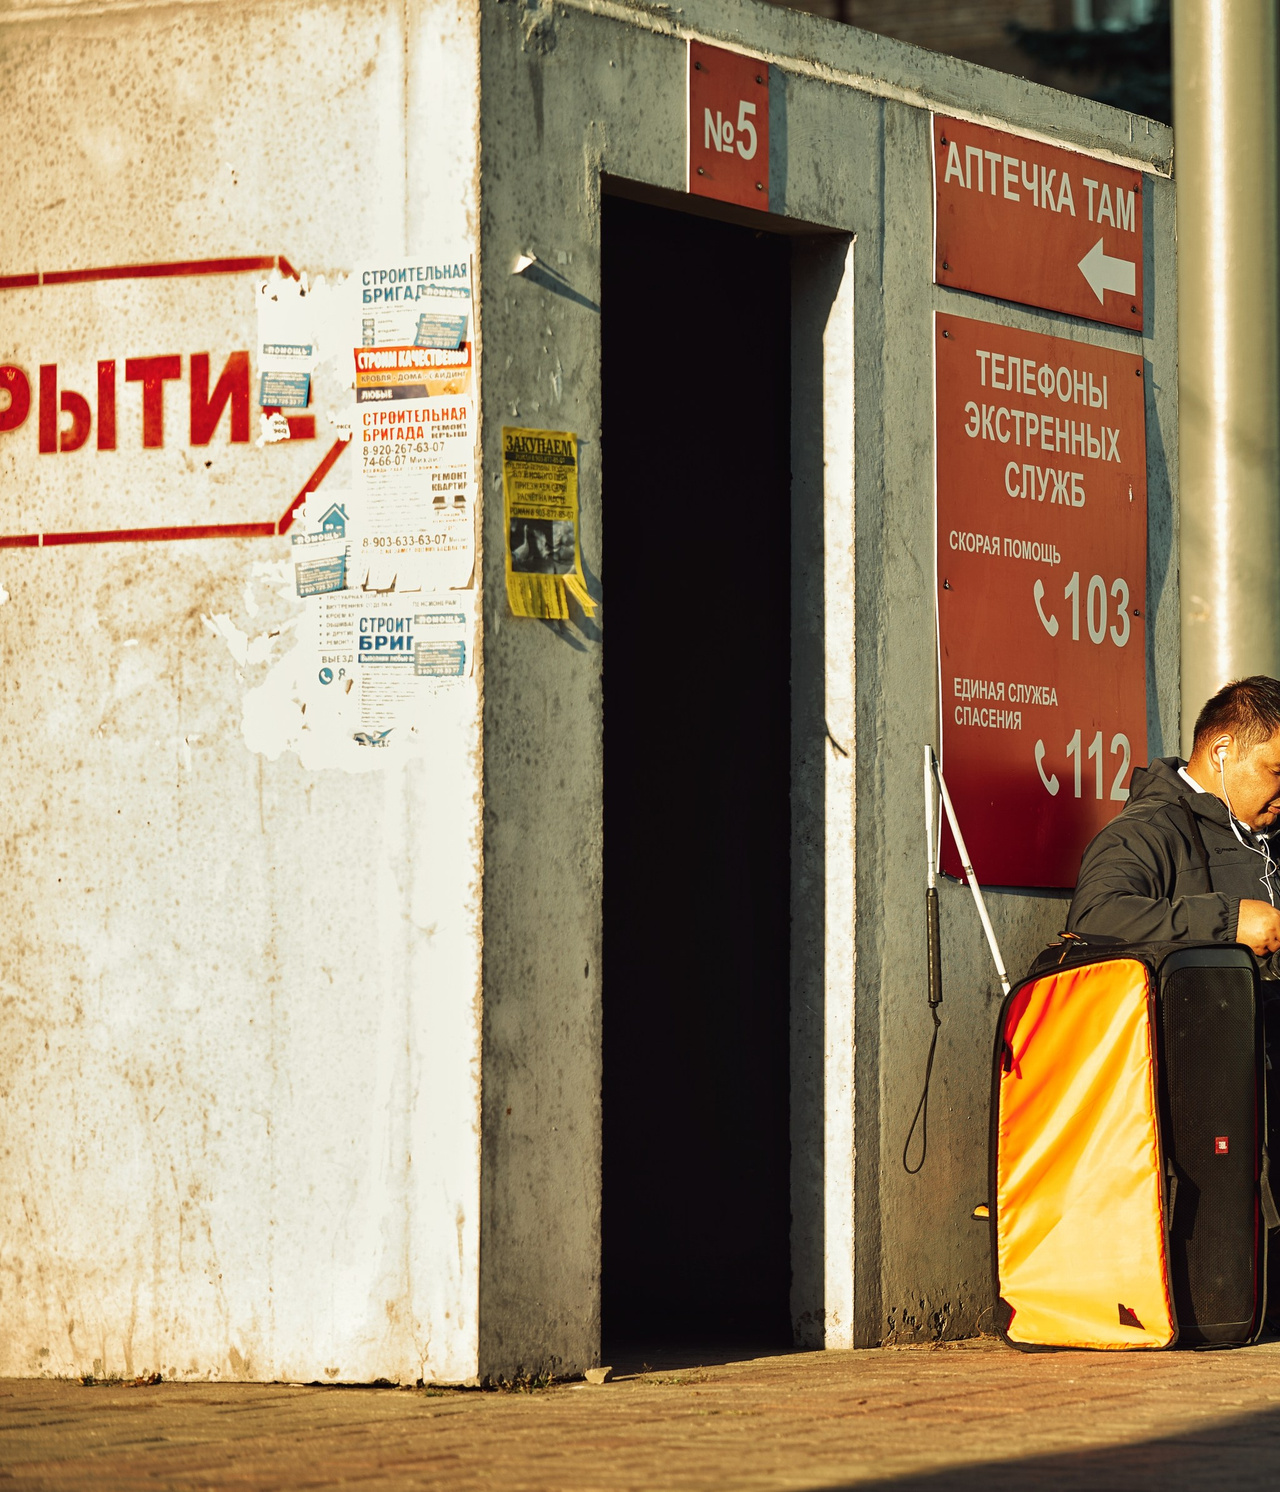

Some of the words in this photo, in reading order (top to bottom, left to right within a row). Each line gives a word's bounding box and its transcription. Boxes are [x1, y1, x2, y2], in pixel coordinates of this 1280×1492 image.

[704, 100, 758, 160] №5
[944, 141, 1076, 217] АПТЕЧКА
[1083, 177, 1136, 233] ТАМ
[362, 263, 467, 286] СТРОИТЕЛЬНАЯ
[358, 350, 398, 370] СТРОИМ
[398, 348, 469, 367] КАЧЕСТВЕННО
[361, 374, 391, 382] КРОВЛЯ
[398, 373, 422, 381] ДОМА
[976, 350, 1108, 410] ТЕЛЕФОНЫ
[361, 389, 393, 400] ЛЮБЫЕ
[363, 407, 467, 426] СТРОИТЕЛЬНАЯ
[363, 426, 424, 441] БРИГАДА
[964, 401, 1121, 463] ЭКСТРЕННЫХ
[363, 441, 445, 456] 8-920-267-63-07
[506, 435, 573, 457] ЗАКУПАЕМ
[363, 455, 406, 467] 74-66-07
[432, 472, 467, 481] РЕМОНТ
[432, 482, 467, 491] КВАРТИР
[1005, 461, 1086, 508] СЛУЖБ
[362, 534, 447, 548] 8-903-633-63-07
[949, 530, 1001, 555] СКОРАЯ
[1004, 538, 1061, 566] ПОМОЩЬ
[1064, 571, 1131, 648] 103
[321, 655, 354, 664] ВЫЕЗД
[953, 677, 1005, 702] ЕДИНАЯ
[1008, 683, 1058, 707] СЛУЖБА
[954, 706, 1022, 730] СПАСЕНИЯ
[1066, 729, 1131, 801] 112
